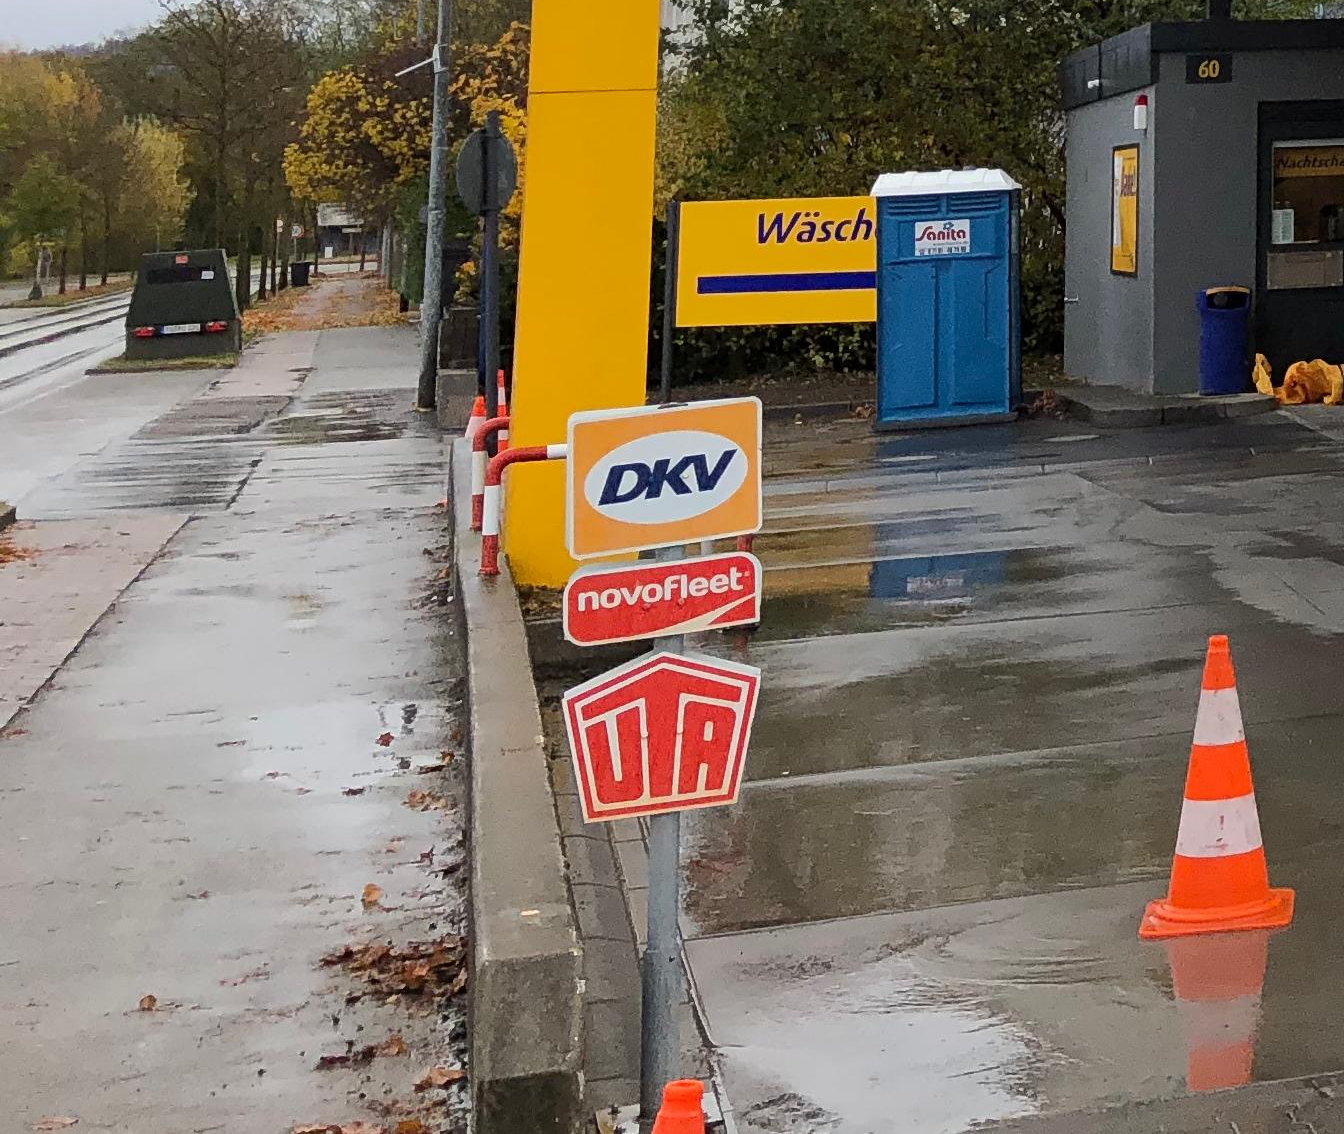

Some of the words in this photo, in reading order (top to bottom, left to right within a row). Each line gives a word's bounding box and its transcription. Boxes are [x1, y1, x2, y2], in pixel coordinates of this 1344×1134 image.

[1198, 59, 1220, 78] 60
[758, 208, 877, 244] Wäsch
[915, 225, 967, 241] Sanita
[598, 448, 738, 506] DKV
[576, 566, 745, 613] novofleet
[581, 664, 746, 807] UTA
